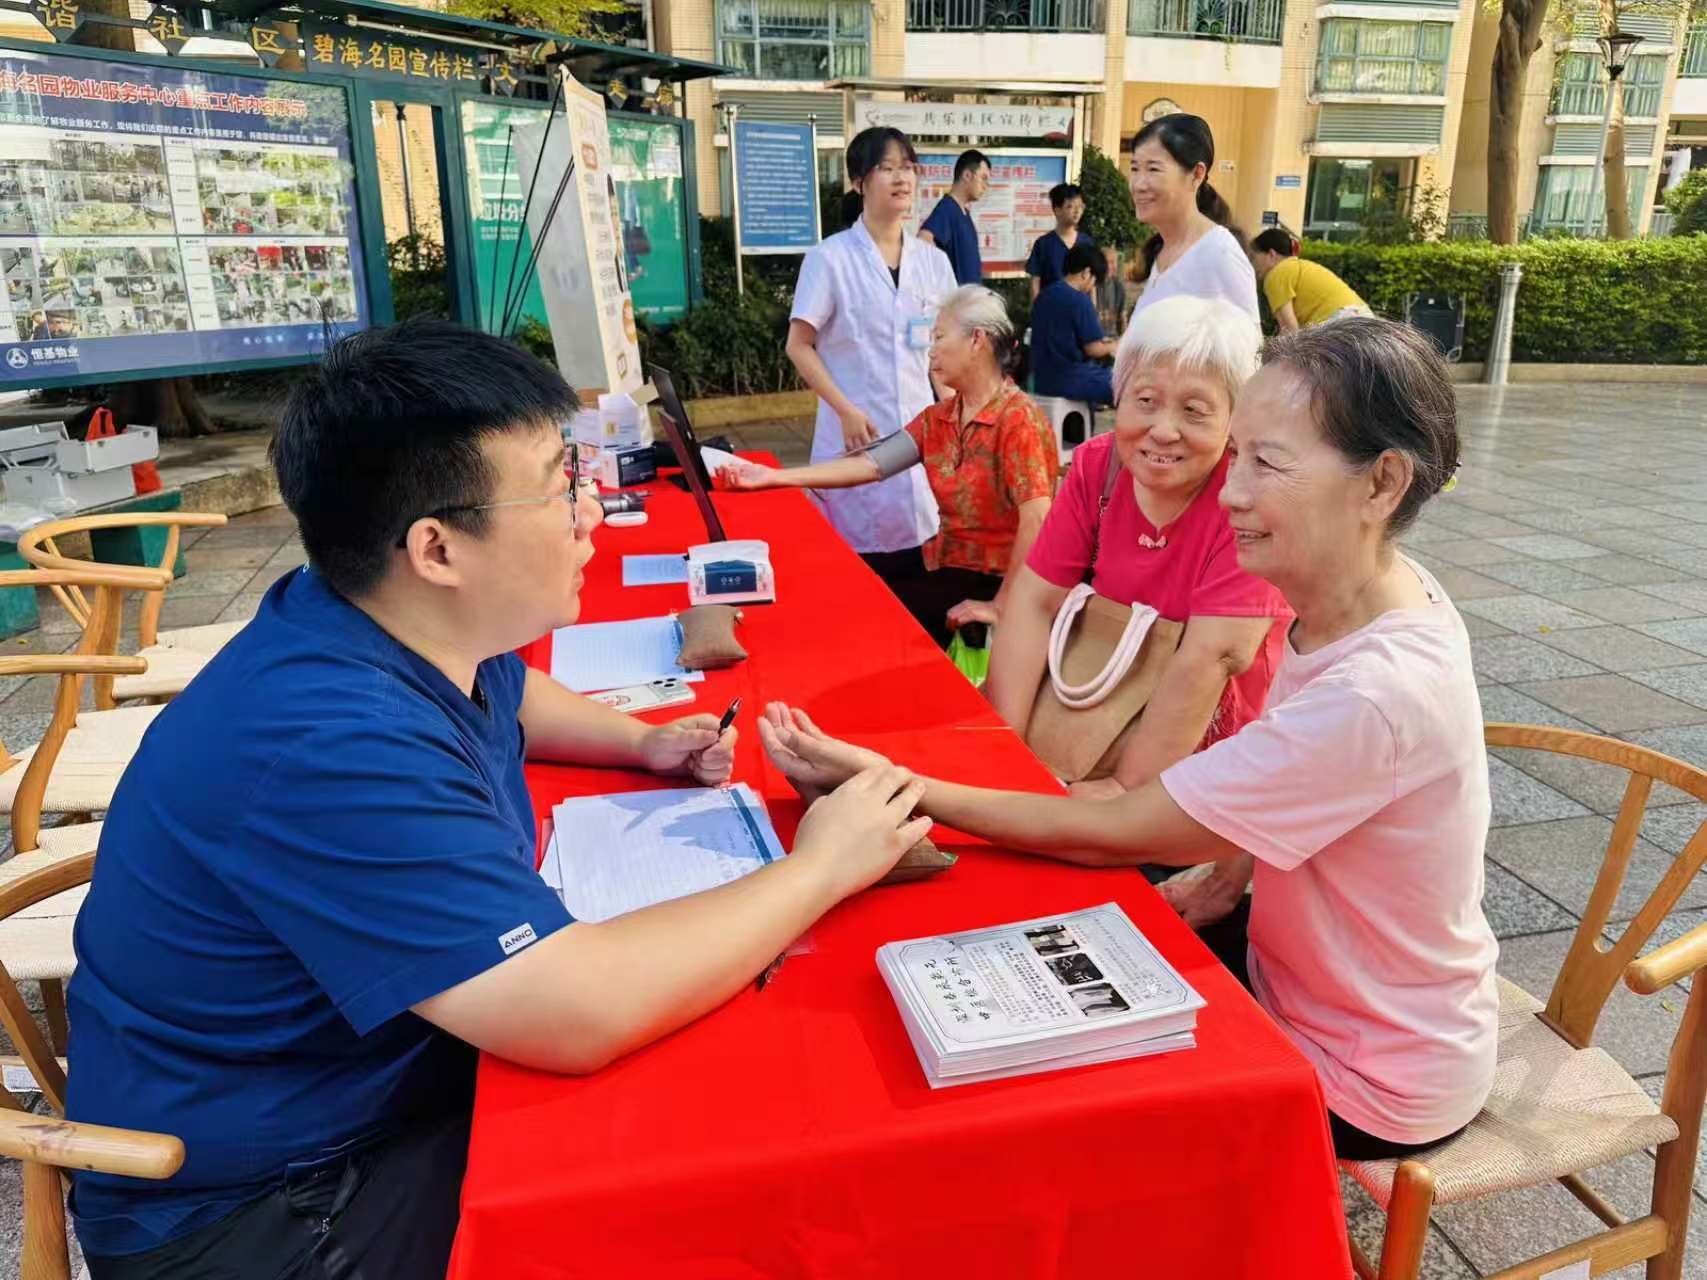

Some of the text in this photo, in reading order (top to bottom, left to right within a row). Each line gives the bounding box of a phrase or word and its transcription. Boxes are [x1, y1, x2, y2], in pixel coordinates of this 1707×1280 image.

[313, 34, 477, 81] 碧海名园宣传栏
